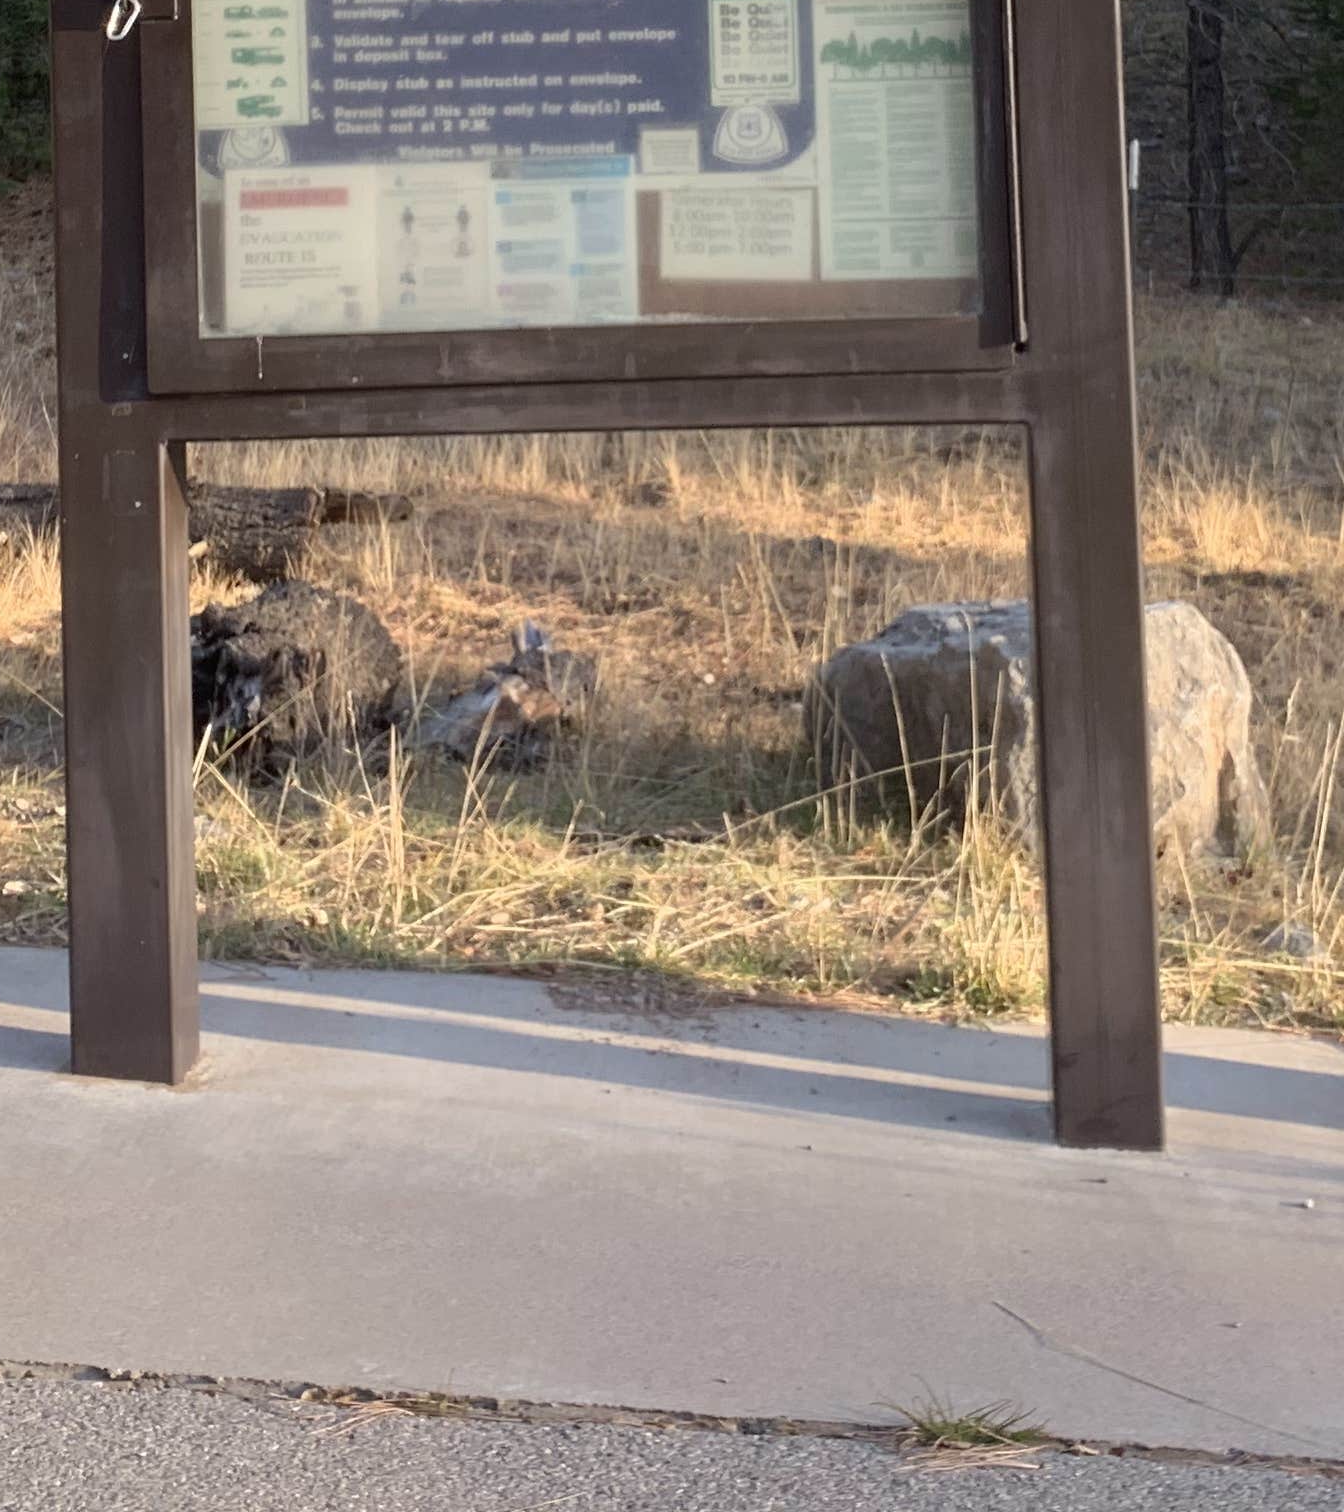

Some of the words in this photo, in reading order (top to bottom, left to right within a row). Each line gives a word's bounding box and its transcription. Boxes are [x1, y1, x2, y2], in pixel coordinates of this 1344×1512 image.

[541, 29, 571, 43] and
[576, 29, 601, 44] put
[608, 28, 676, 41] envelope
